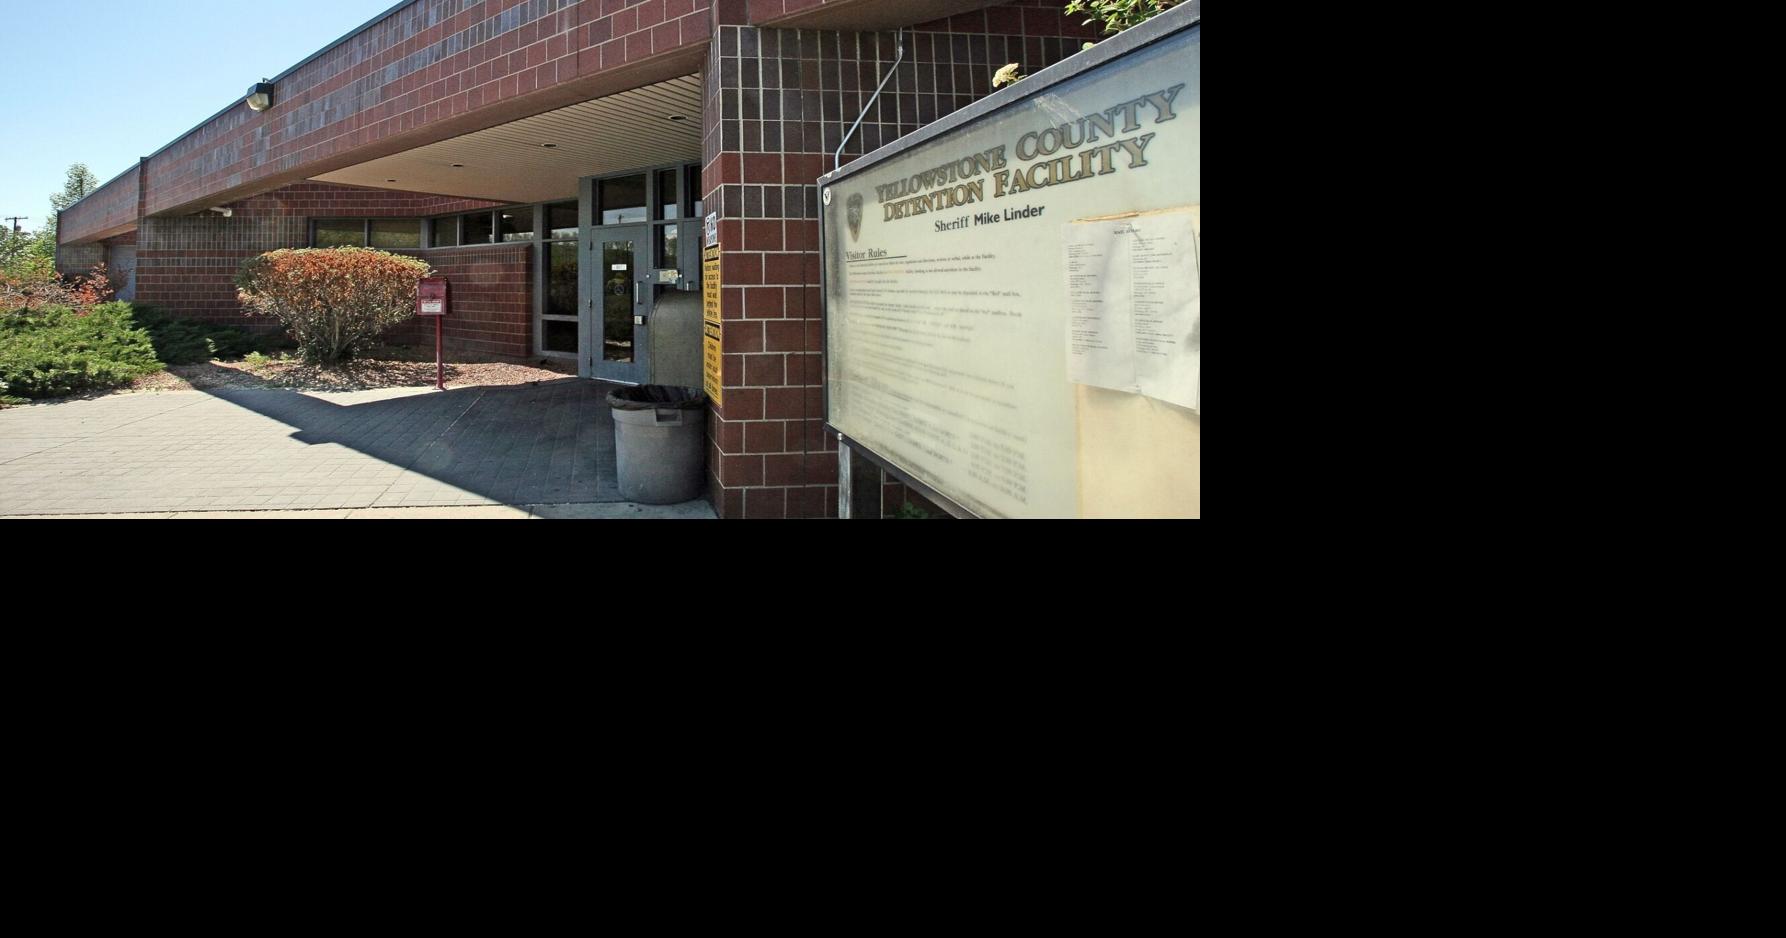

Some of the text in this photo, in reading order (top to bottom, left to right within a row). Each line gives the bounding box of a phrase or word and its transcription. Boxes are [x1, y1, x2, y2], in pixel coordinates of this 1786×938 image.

[874, 83, 1186, 205] YELLOWSTONE COUNTY
[883, 132, 1156, 222] DETENTION FACILITY
[934, 204, 1046, 233] Sheriff Mike Linder
[846, 247, 888, 260] Visitor Rules
